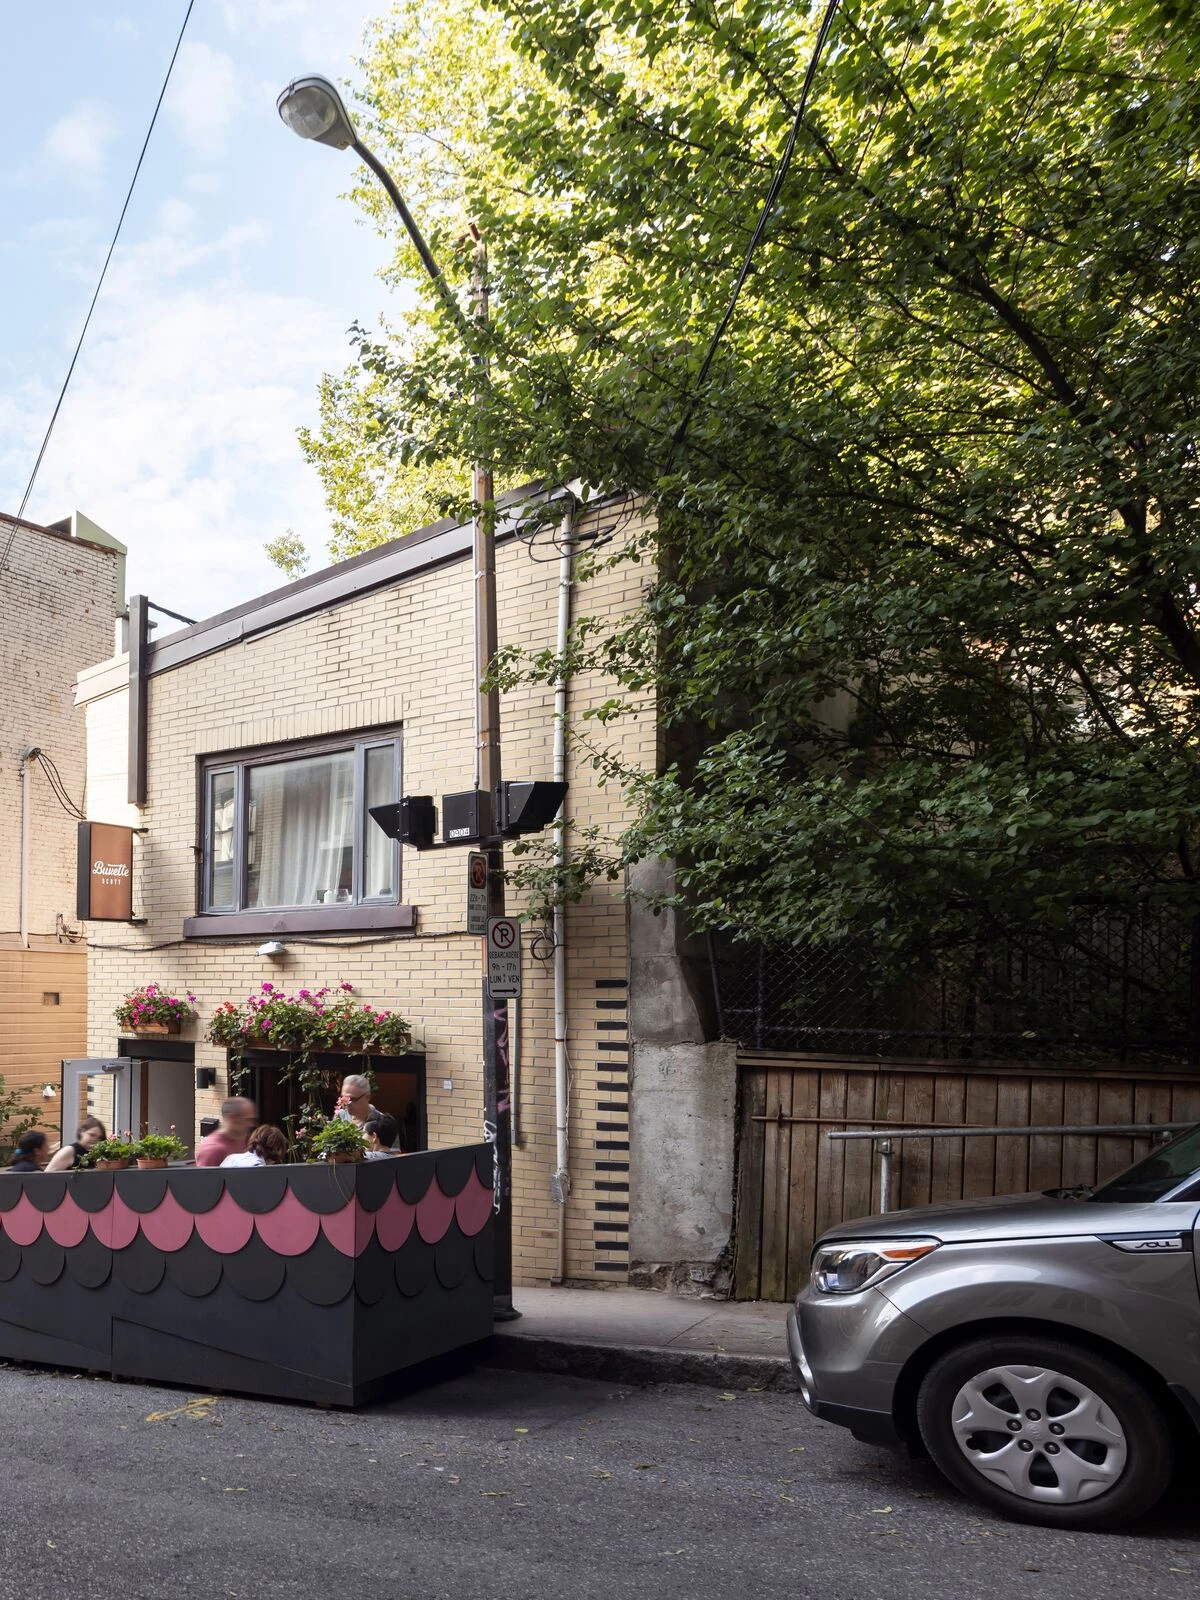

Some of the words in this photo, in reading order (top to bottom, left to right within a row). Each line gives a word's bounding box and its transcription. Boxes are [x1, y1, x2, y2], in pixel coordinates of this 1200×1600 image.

[92, 860, 130, 877] Buvette
[490, 975, 502, 984] LUN
[508, 974, 520, 984] VEN
[1135, 1241, 1179, 1249] SOUL
